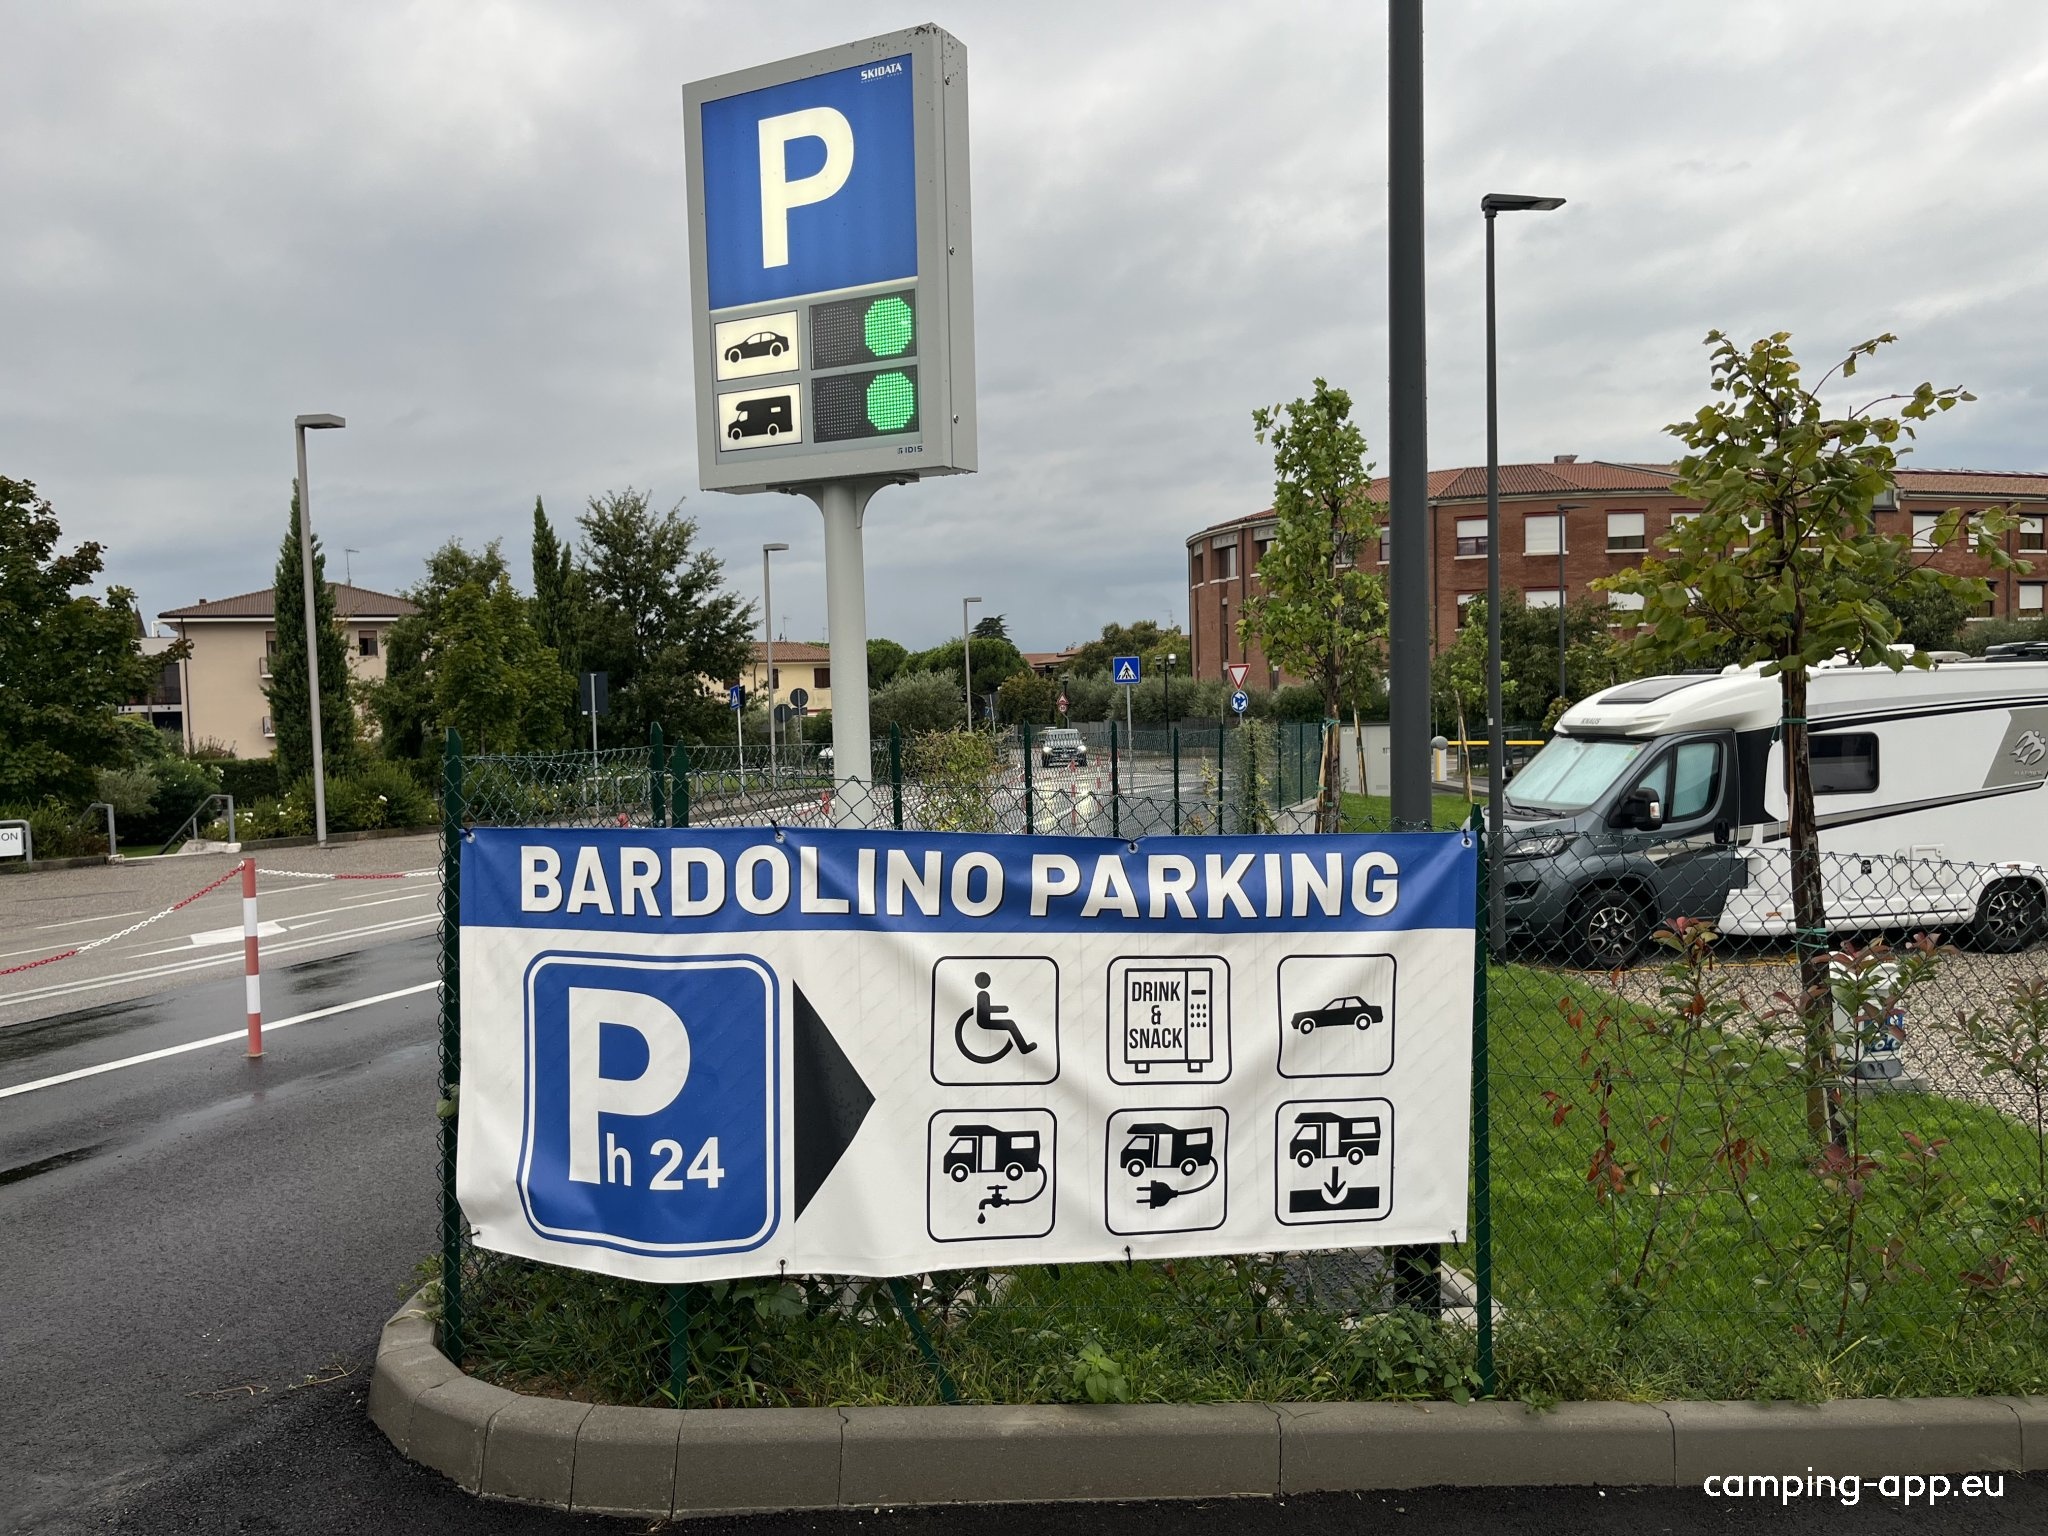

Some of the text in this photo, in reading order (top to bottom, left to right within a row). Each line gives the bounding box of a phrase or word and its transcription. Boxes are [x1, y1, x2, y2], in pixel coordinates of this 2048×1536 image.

[861, 62, 903, 81] SKIDATA
[758, 106, 854, 269] P
[520, 845, 1399, 919] BARDOLINO PARKING
[1131, 981, 1181, 1002] DRINK
[1150, 1004, 1162, 1026] &
[1129, 1027, 1183, 1050] SNACK
[568, 986, 691, 1185] P
[606, 1132, 725, 1190] h 24
